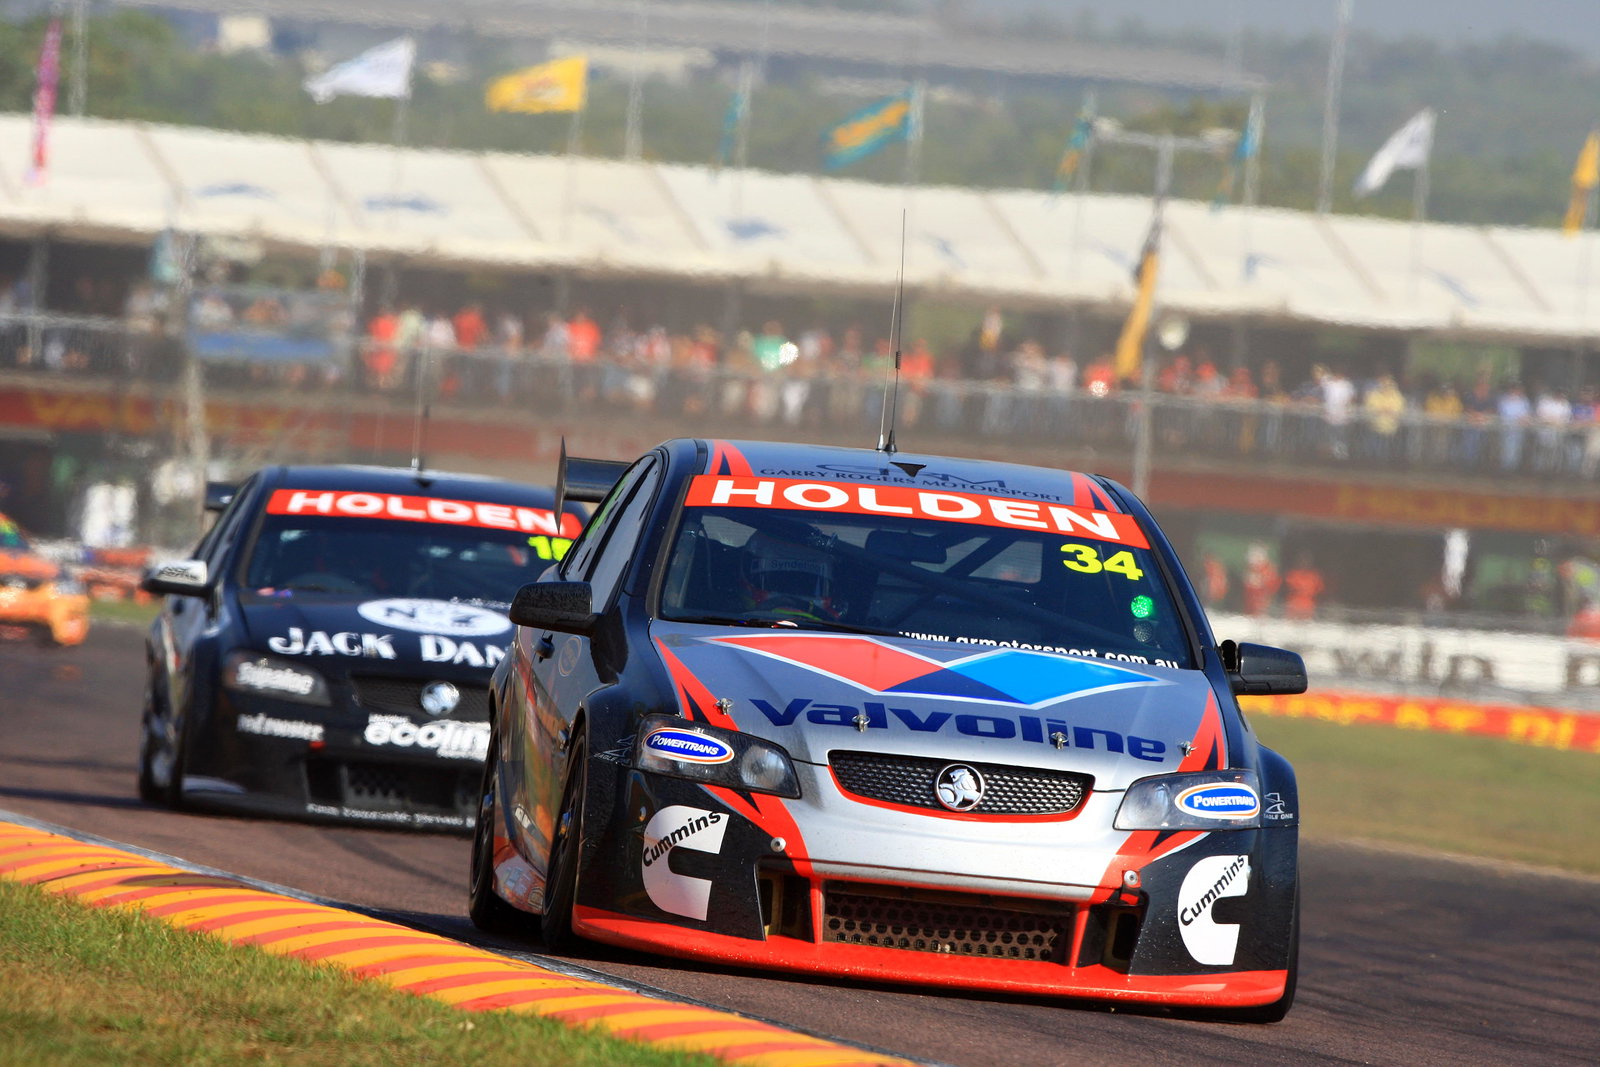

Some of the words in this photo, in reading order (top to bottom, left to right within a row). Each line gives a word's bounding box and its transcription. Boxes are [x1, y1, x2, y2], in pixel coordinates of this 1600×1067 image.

[760, 468, 828, 479] GARRY
[835, 472, 916, 485] ROGERS
[922, 479, 1064, 502] MOTORSPORT
[288, 492, 565, 536] HOLDEN
[711, 479, 1121, 539] HOLDEN
[1060, 543, 1143, 581] 34
[269, 627, 397, 661] JACK
[420, 635, 508, 667] DAN
[651, 734, 720, 756] POWERTRANS
[748, 699, 1166, 763] Valvoline
[1193, 795, 1255, 808] POWERTRANS
[642, 811, 722, 867] Cummins
[1180, 854, 1246, 927] Cummins
